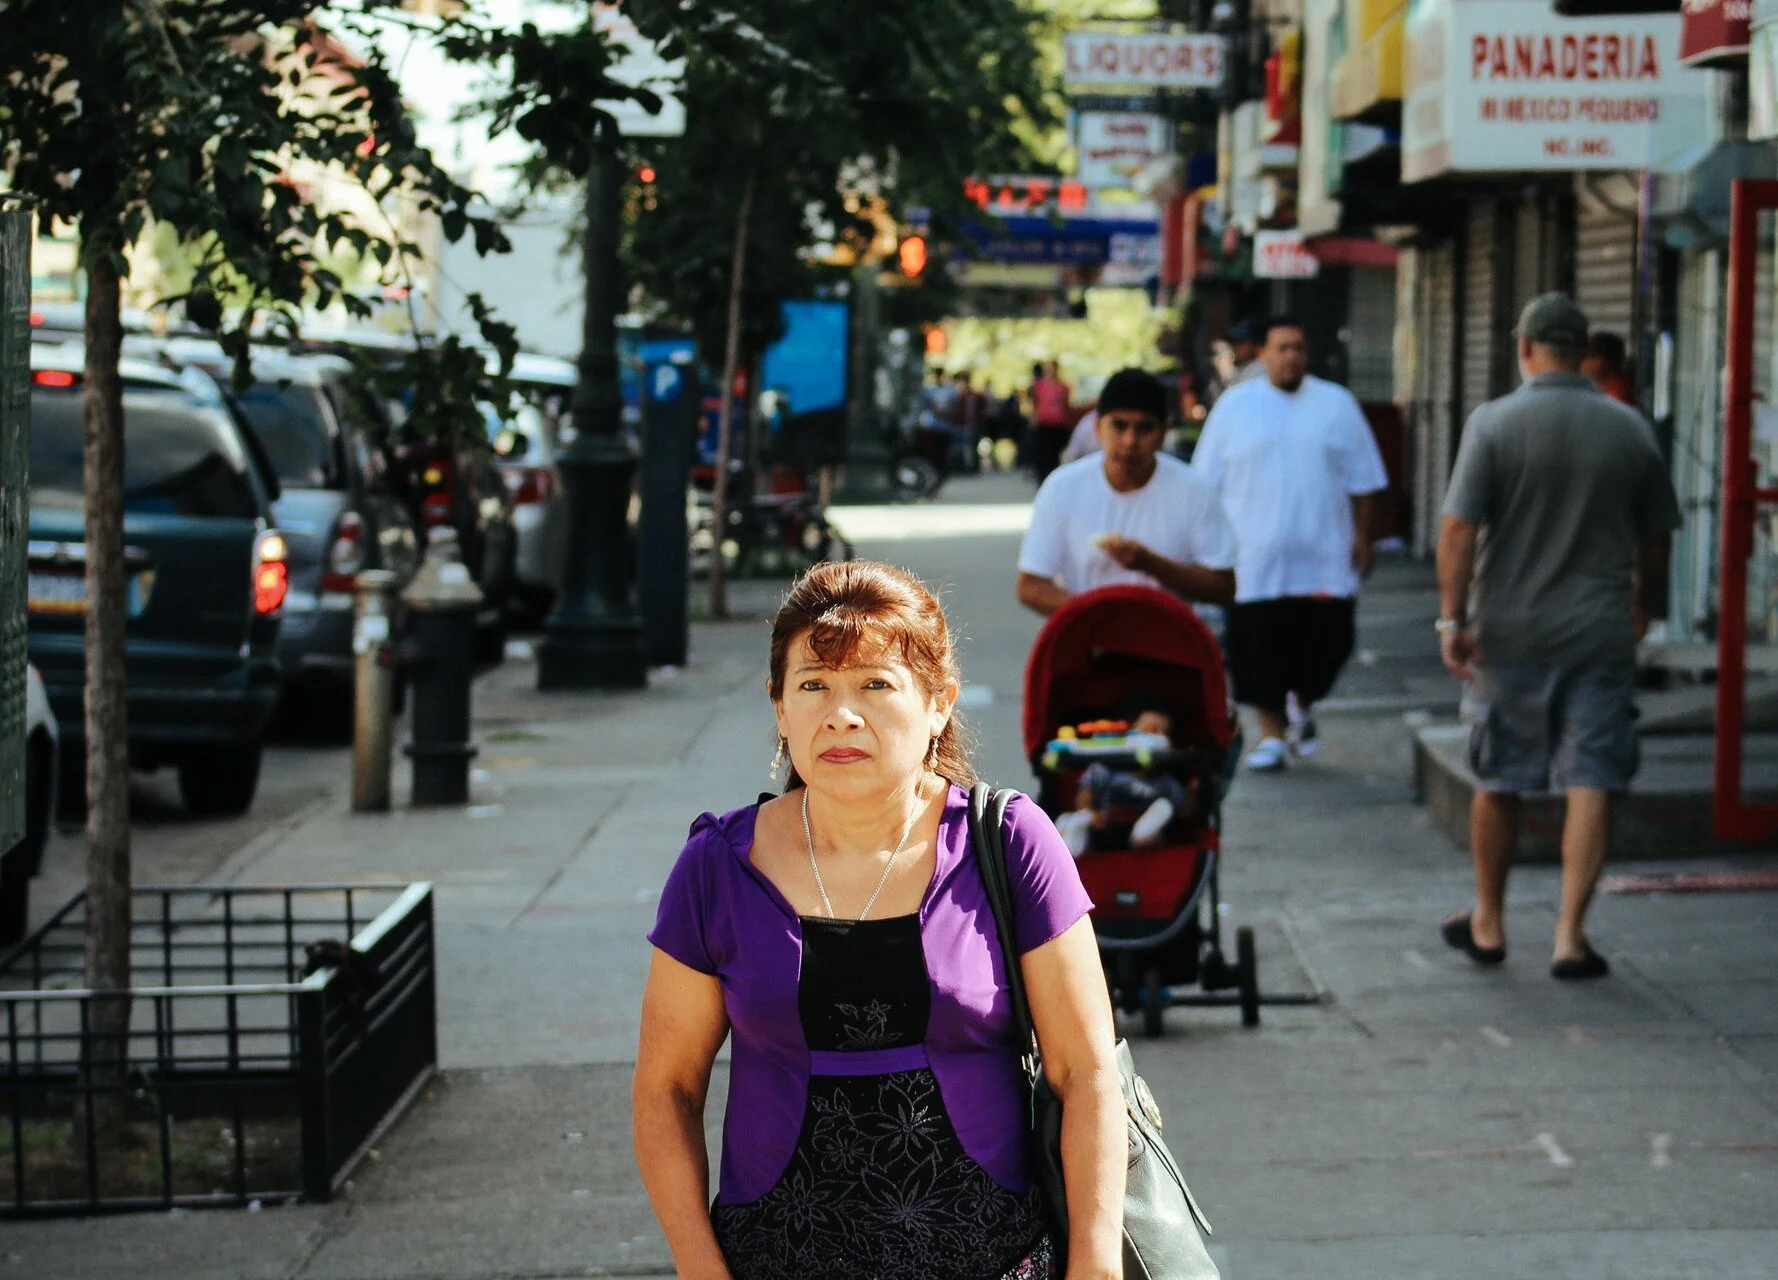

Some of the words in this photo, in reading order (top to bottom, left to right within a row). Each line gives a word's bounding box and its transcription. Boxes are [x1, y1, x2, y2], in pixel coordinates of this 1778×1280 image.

[1066, 41, 1218, 77] LIQUORS
[1471, 33, 1659, 80] PANADERIA
[1503, 96, 1571, 122] MEXICO
